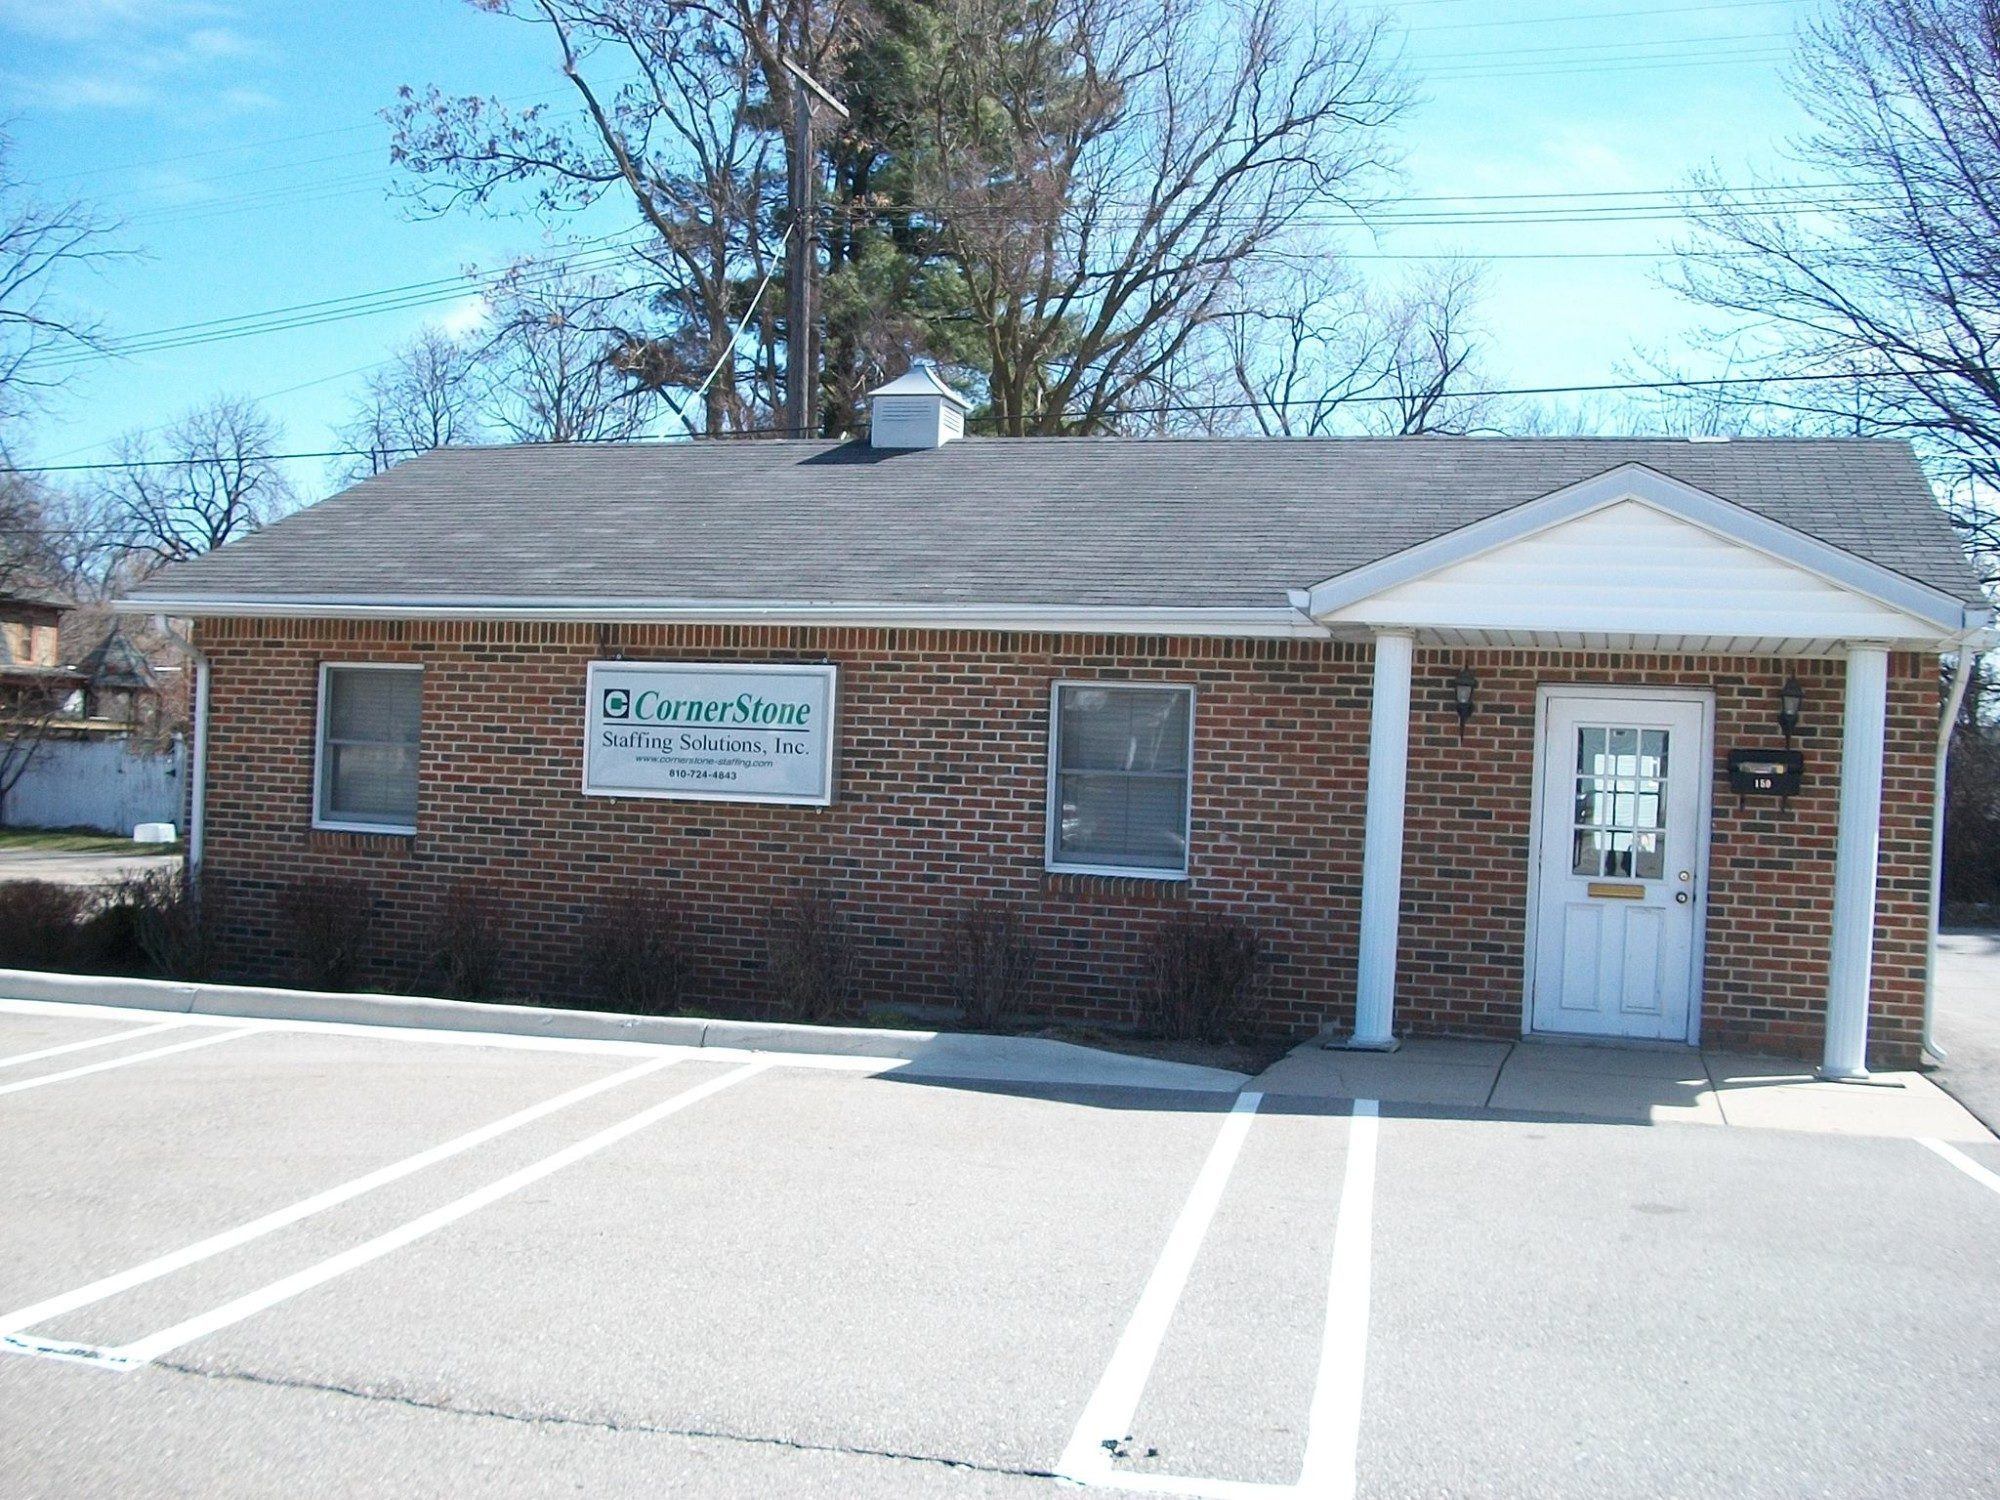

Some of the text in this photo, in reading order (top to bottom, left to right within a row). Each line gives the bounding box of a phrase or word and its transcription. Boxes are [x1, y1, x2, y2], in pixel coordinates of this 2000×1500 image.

[635, 690, 811, 725] CornerStone
[602, 730, 810, 755] Staffing Solutions, Inc.
[635, 754, 774, 768] www.cornerstone-staffing.com
[669, 769, 737, 781] 810-724-4843
